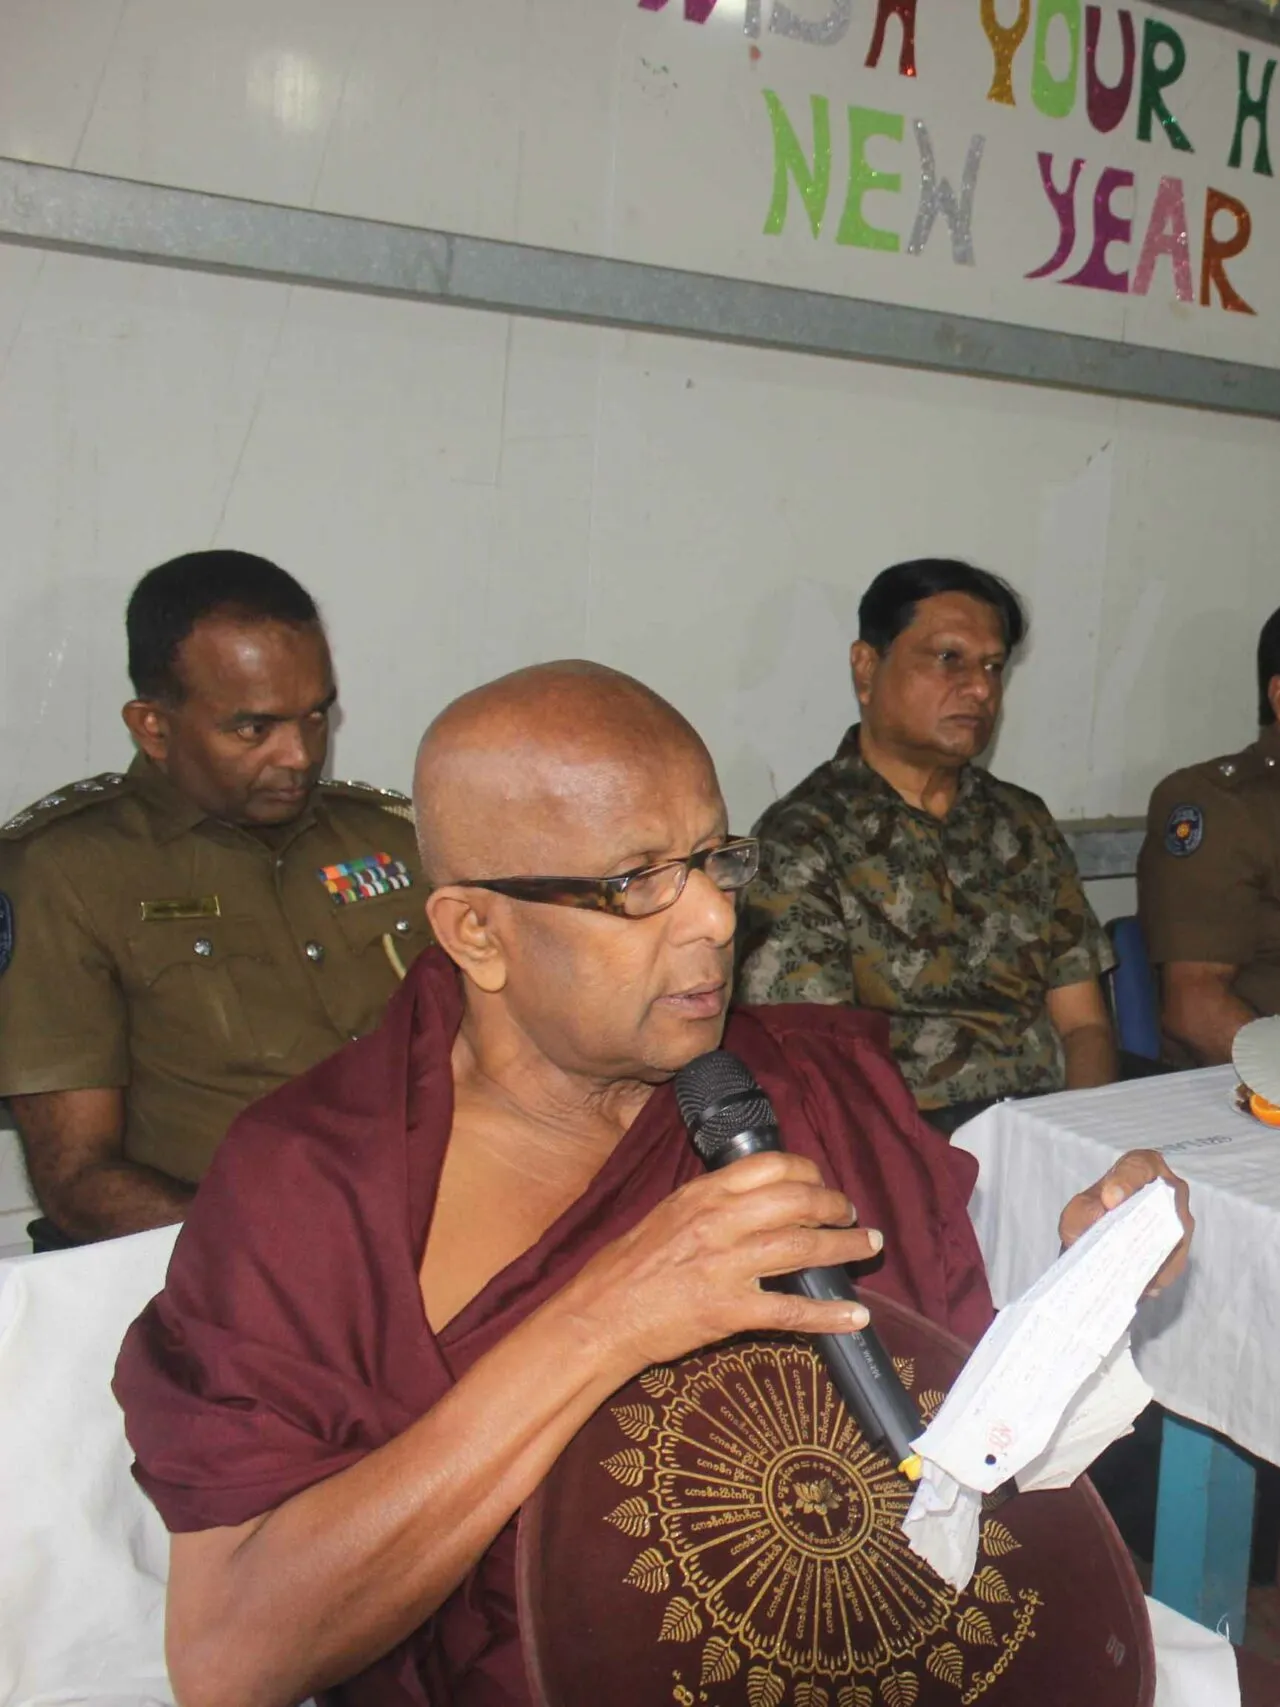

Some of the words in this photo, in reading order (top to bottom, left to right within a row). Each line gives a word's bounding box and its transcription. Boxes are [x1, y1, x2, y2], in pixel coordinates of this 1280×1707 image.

[980, 0, 1195, 154] YOUR
[762, 88, 987, 268] NEW
[1022, 151, 1258, 316] YEAR
